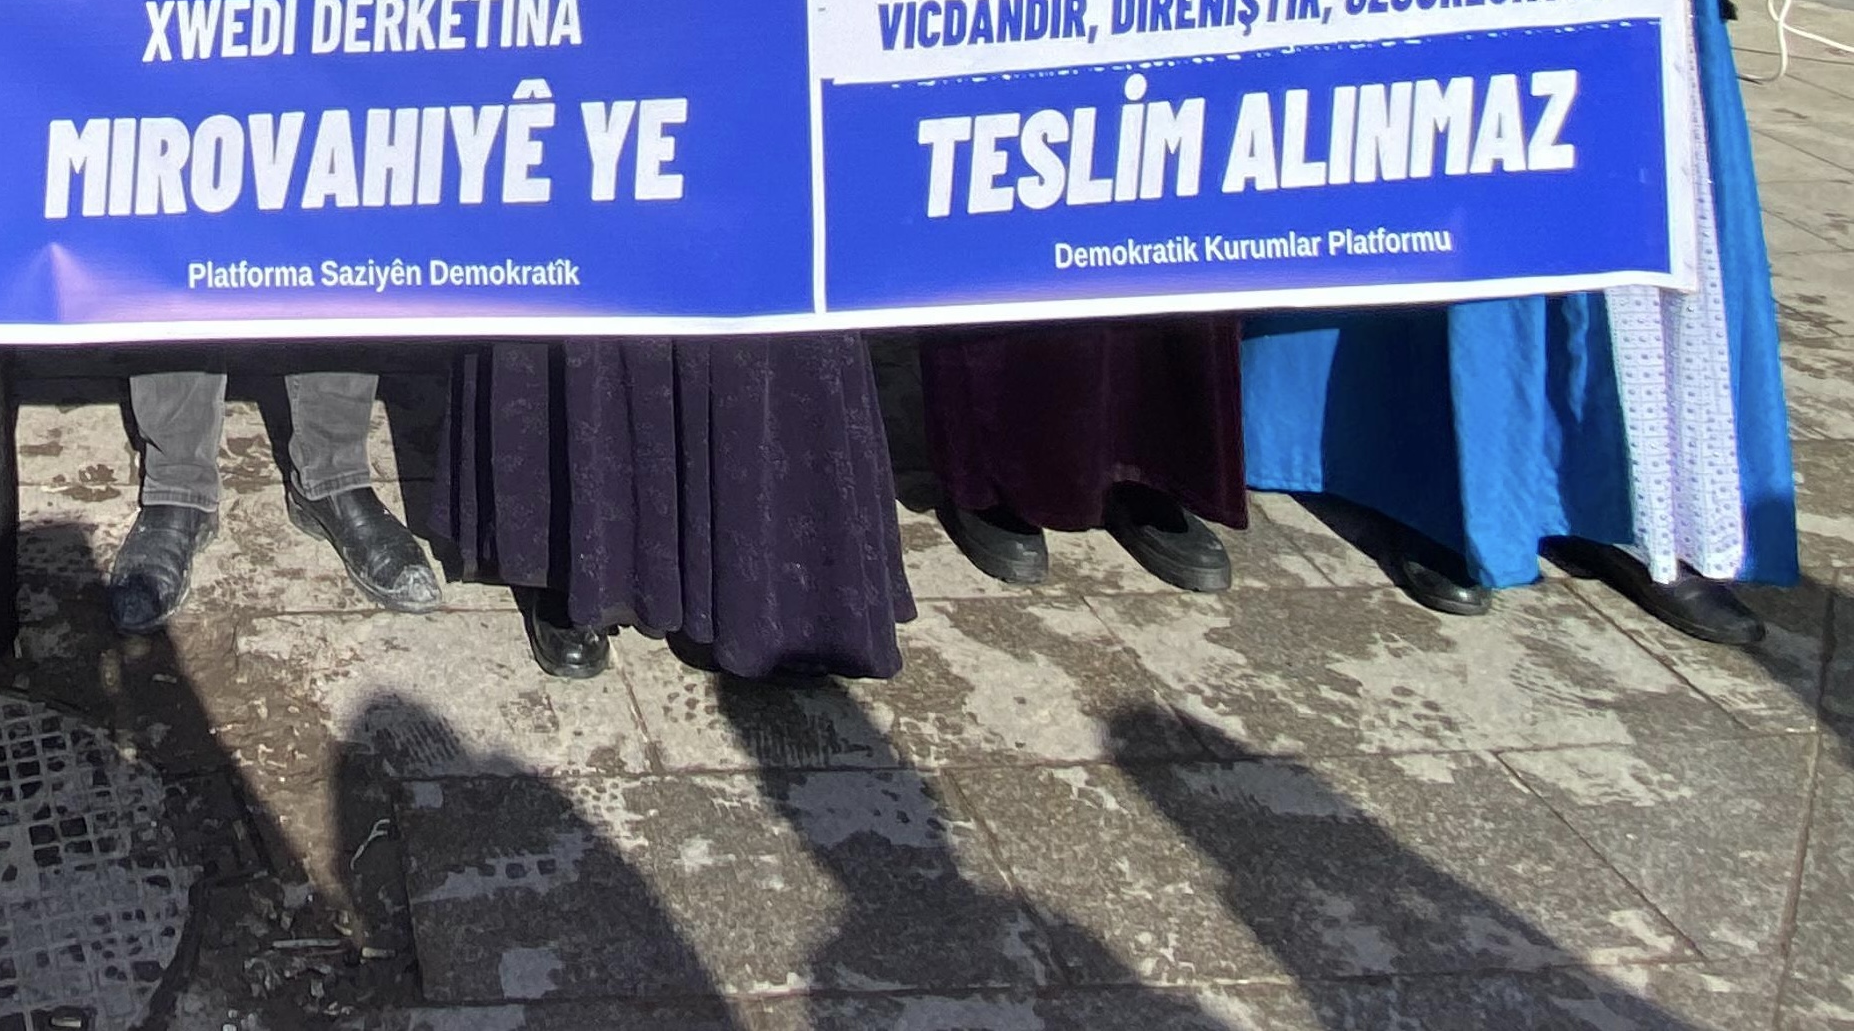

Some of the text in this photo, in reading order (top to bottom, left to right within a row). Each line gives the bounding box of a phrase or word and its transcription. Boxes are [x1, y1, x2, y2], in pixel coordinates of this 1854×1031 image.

[44, 78, 688, 219] MIROVAHIYÊ YE
[918, 69, 1577, 219] TESLİM ALINMAZ
[188, 257, 581, 293] Platforma Saziyên Demokratîk
[1054, 226, 1453, 270] Demokratik Kurumlar Platformu
